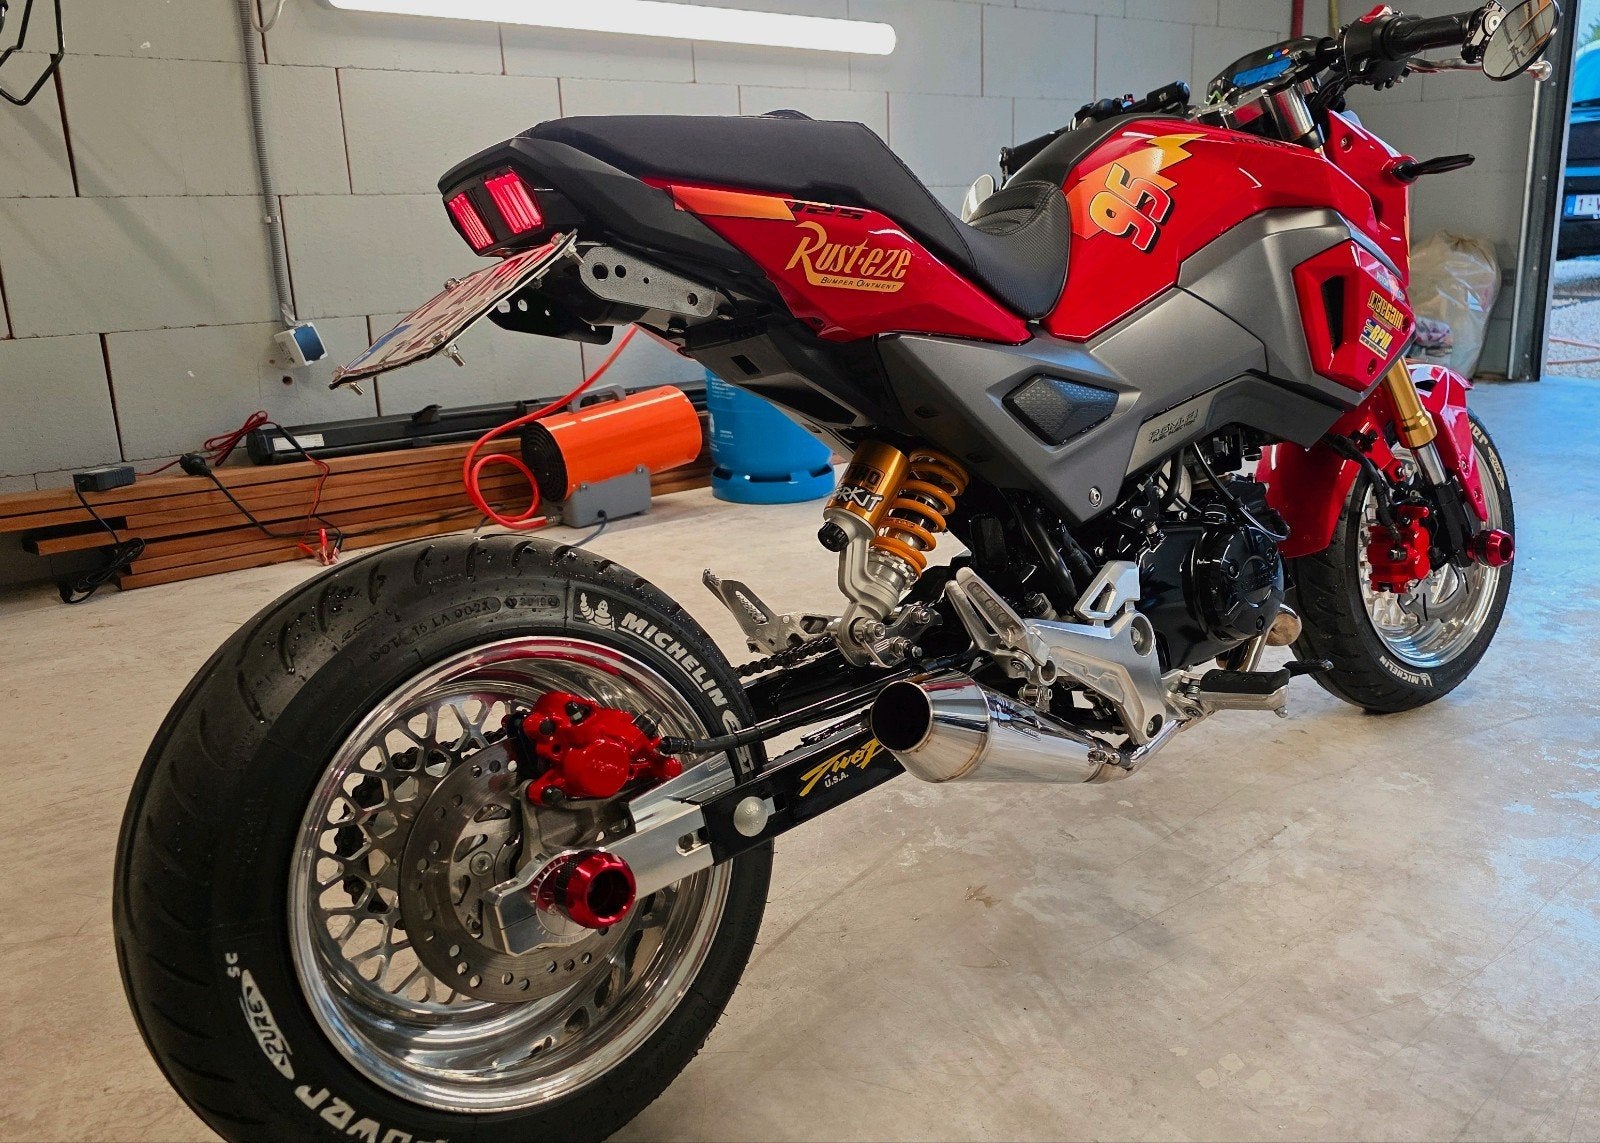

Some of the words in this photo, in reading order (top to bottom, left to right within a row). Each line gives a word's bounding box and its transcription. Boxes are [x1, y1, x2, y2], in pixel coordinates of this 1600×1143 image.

[1089, 163, 1175, 253] 95
[1369, 324, 1394, 351] RPM
[620, 612, 728, 707] MICHELIN
[1380, 655, 1420, 685] MICHELIN
[824, 772, 849, 788] U.S.A.
[224, 952, 241, 978] SC
